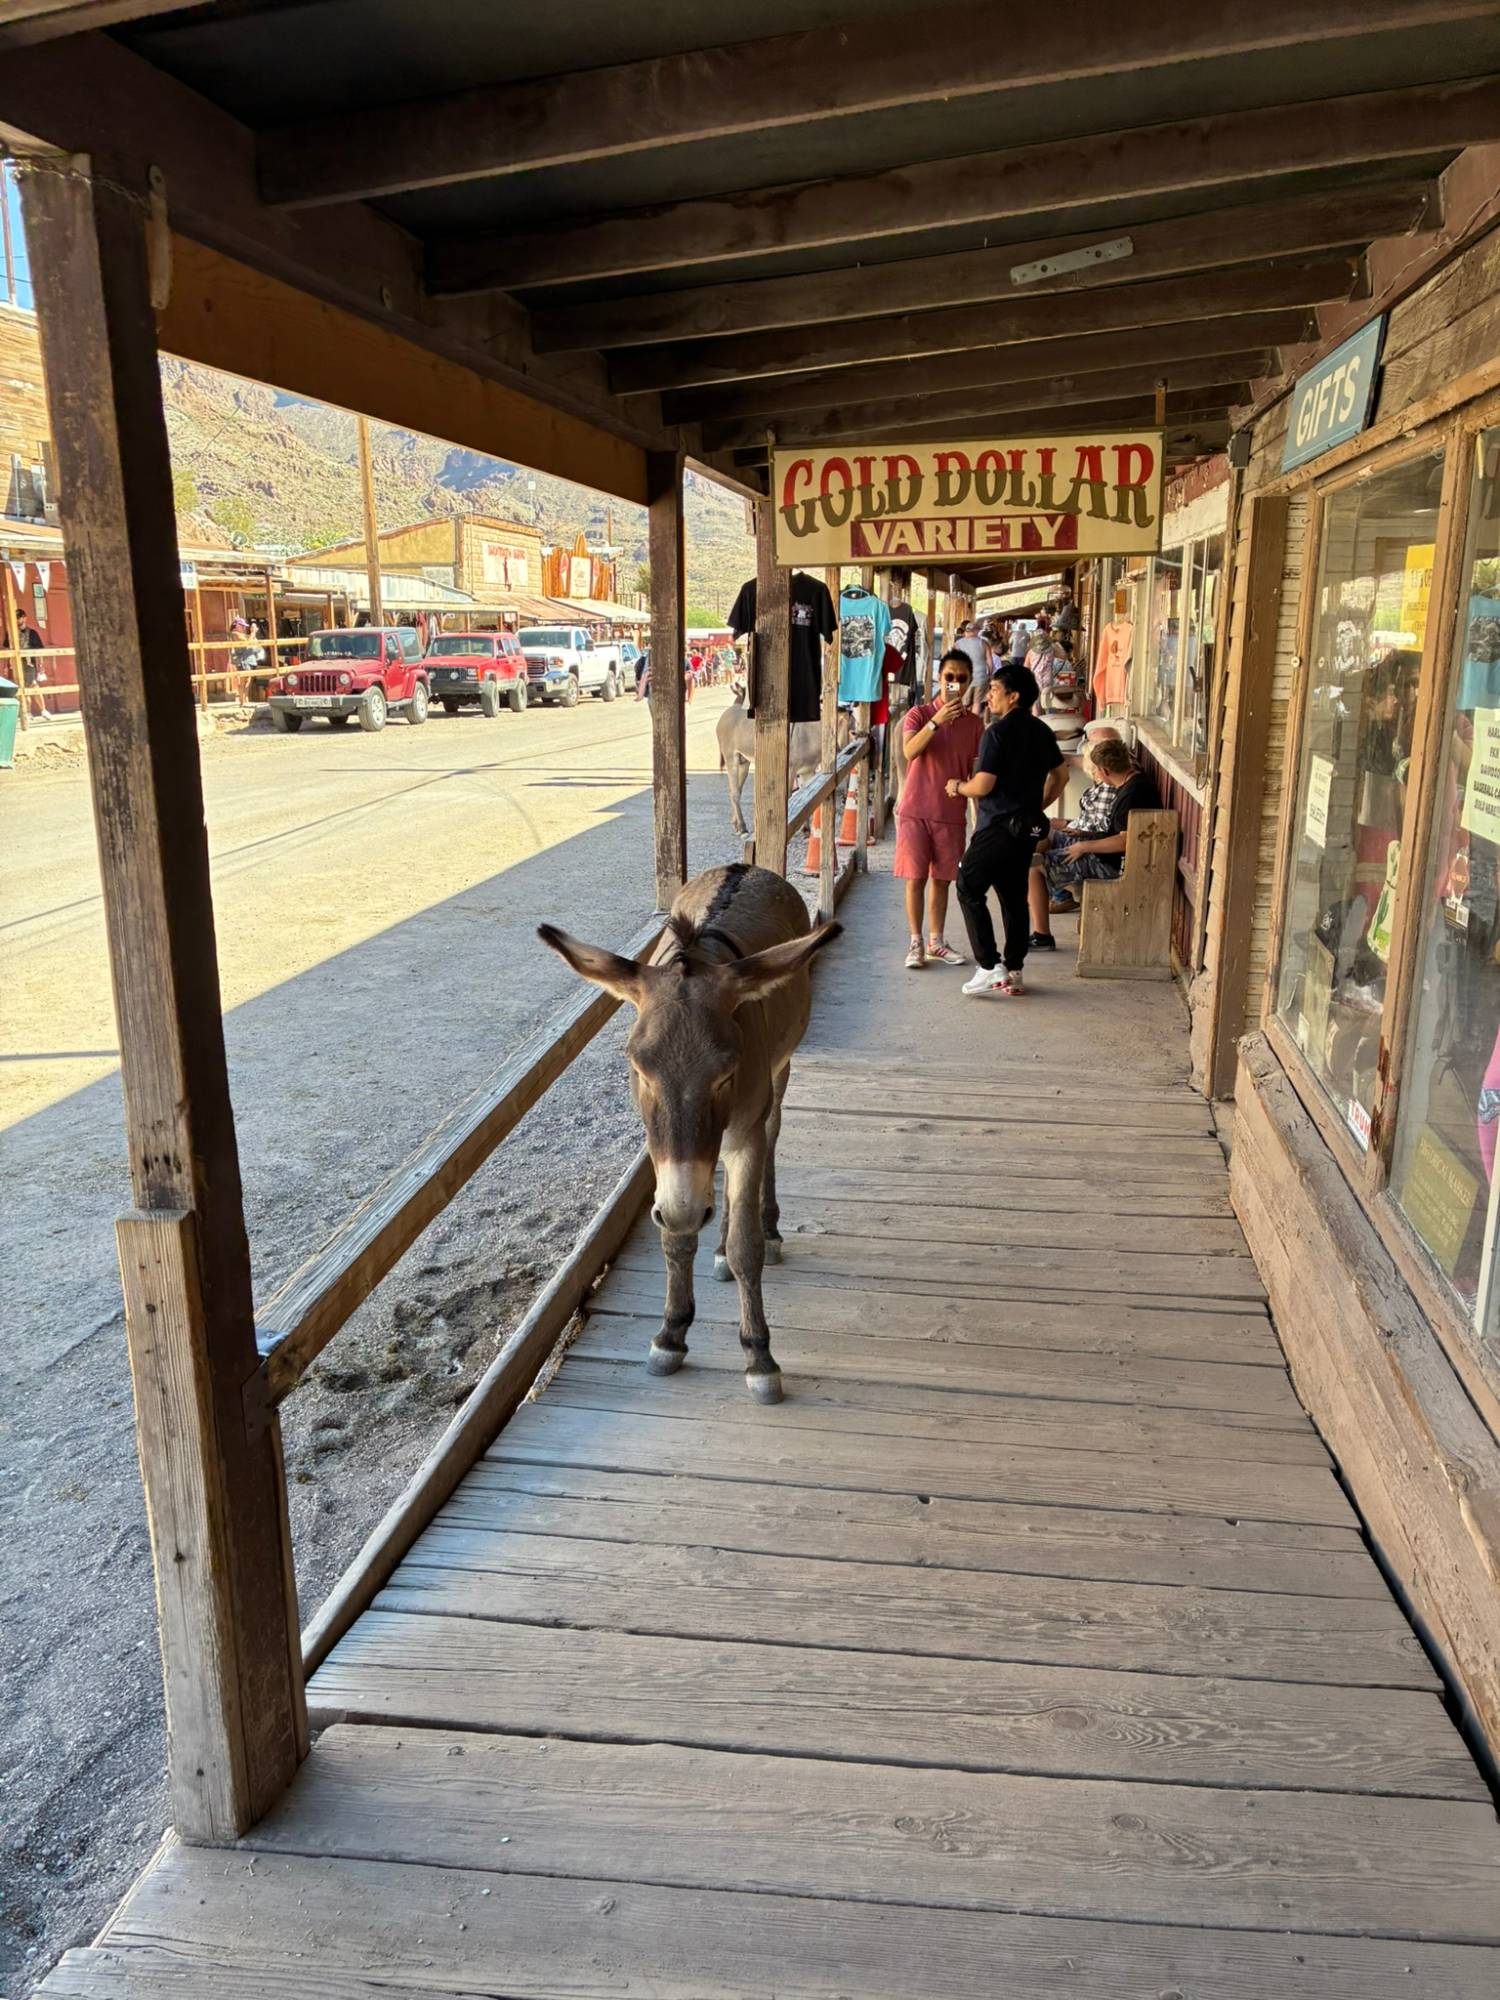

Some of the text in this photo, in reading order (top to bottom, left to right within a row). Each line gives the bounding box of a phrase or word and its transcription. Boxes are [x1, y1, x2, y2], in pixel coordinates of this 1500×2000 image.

[1296, 355, 1361, 447] GIFTS
[779, 443, 1155, 538] GOLD DOLLAR
[859, 514, 1064, 555] VARIETY
